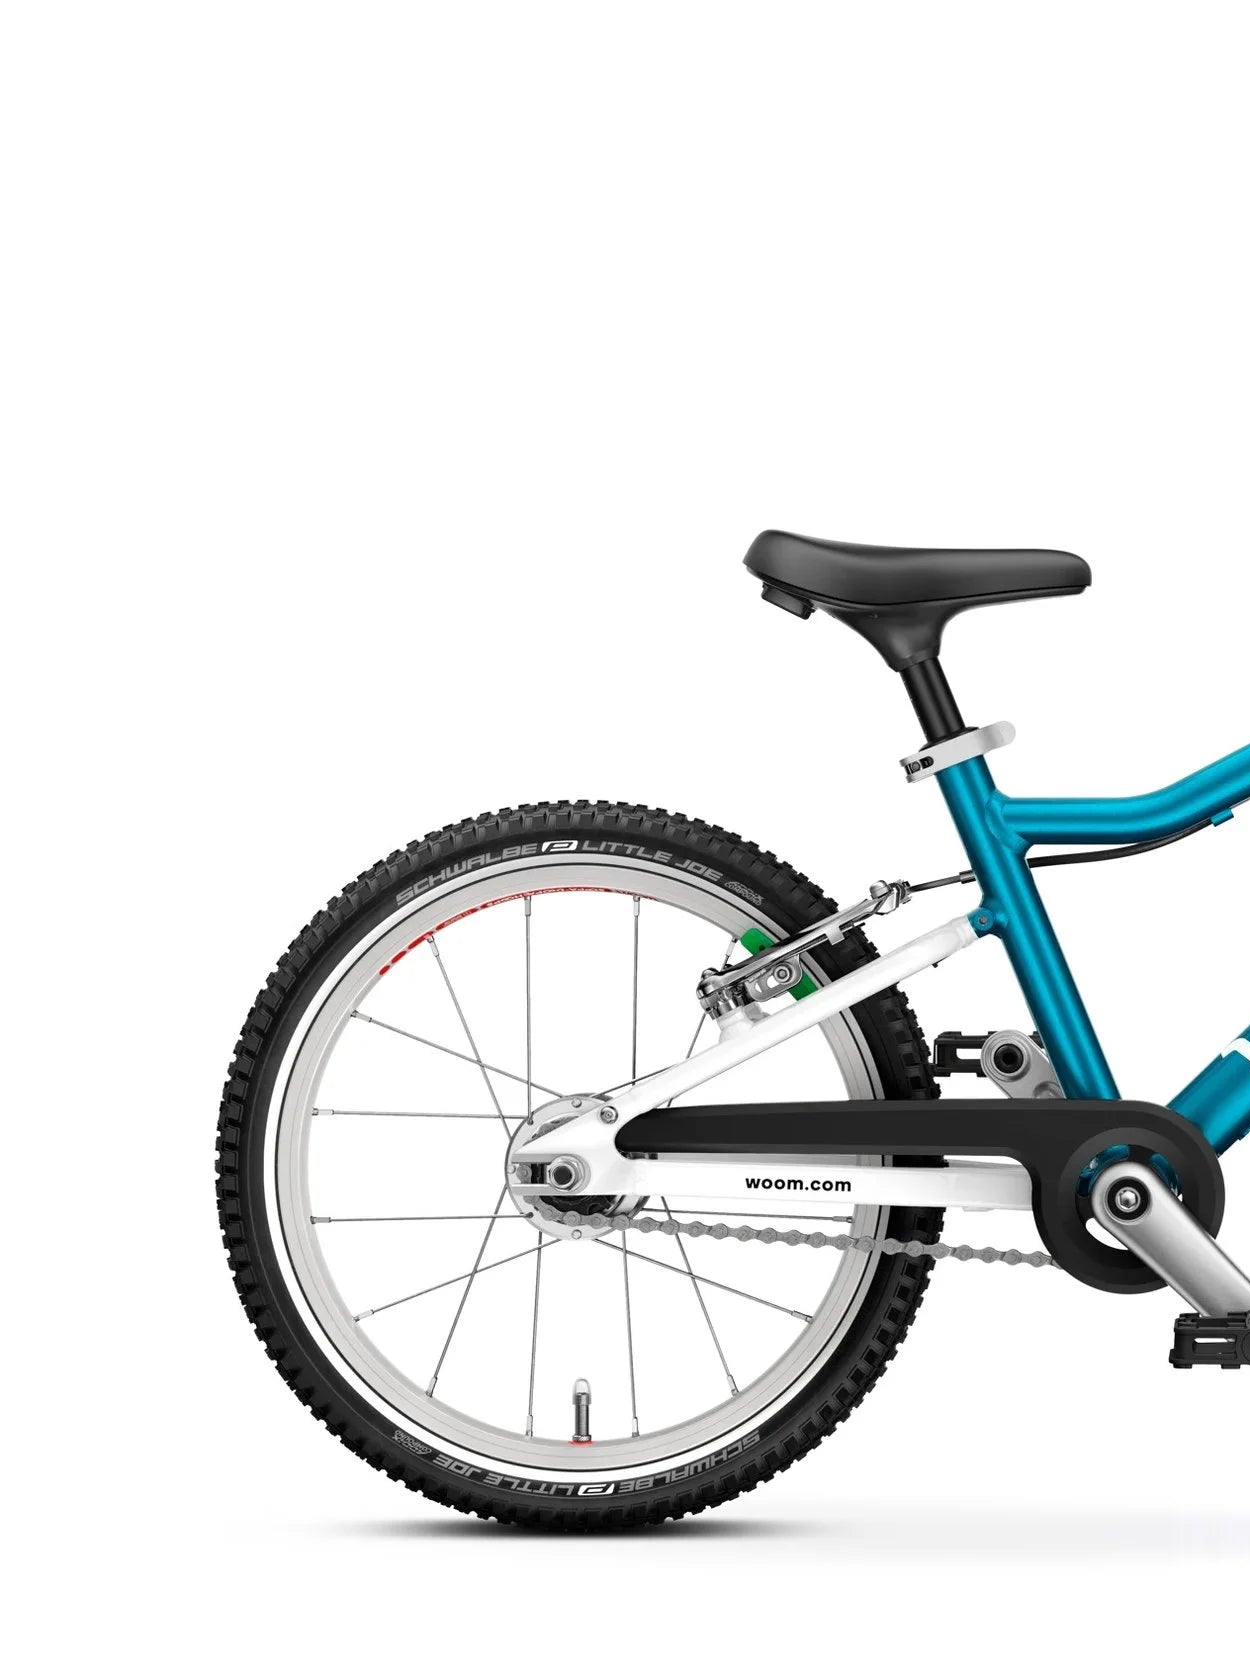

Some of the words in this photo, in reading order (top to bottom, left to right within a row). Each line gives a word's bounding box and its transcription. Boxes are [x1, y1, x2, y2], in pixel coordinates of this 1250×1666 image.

[396, 843, 538, 906] SCHWALBE
[583, 840, 673, 863] LITTLE
[674, 859, 724, 882] JOE
[745, 1177, 852, 1192] woom.com
[432, 1454, 483, 1478] JOE
[618, 1428, 762, 1494] SCHWALBE
[484, 1474, 572, 1497] LITTLE
